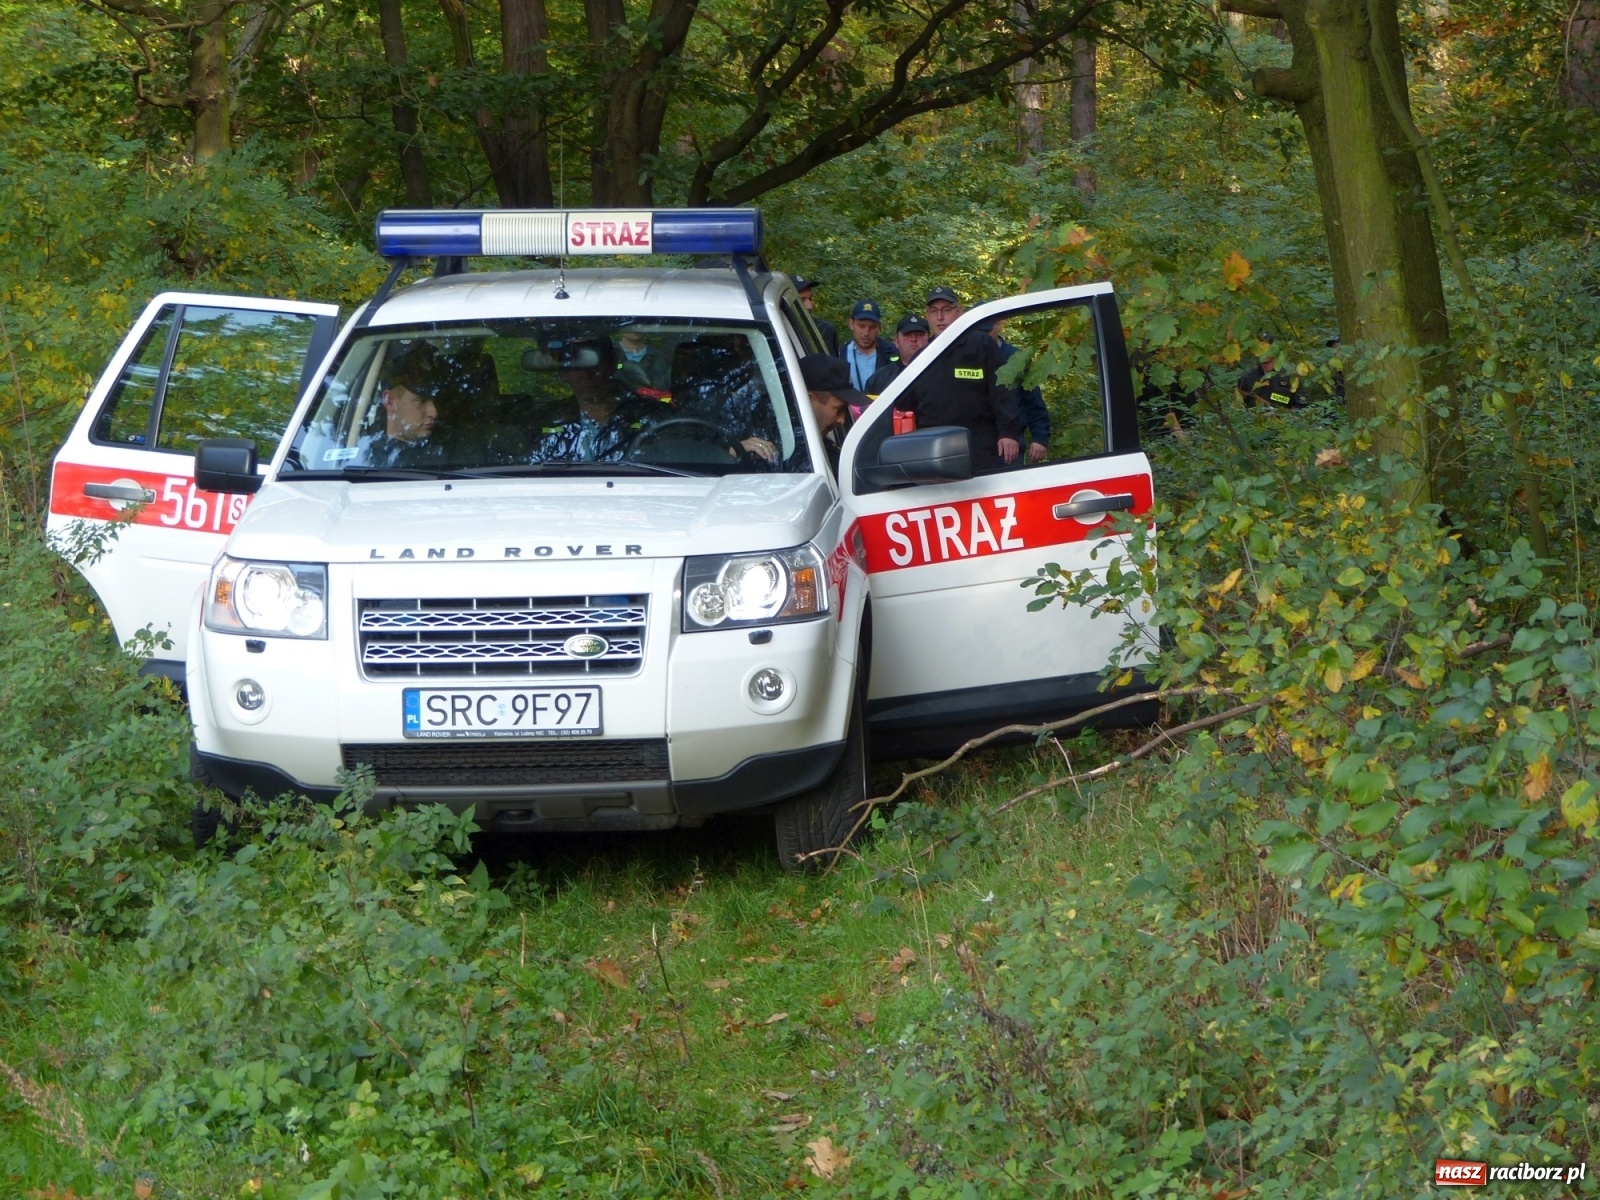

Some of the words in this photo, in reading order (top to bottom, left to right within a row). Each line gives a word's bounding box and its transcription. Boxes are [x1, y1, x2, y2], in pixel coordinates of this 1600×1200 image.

[369, 547, 475, 559] LAND
[504, 544, 643, 558] ROVER
[426, 694, 498, 726] SRC
[511, 692, 592, 726] 9F97
[407, 714, 419, 724] PL
